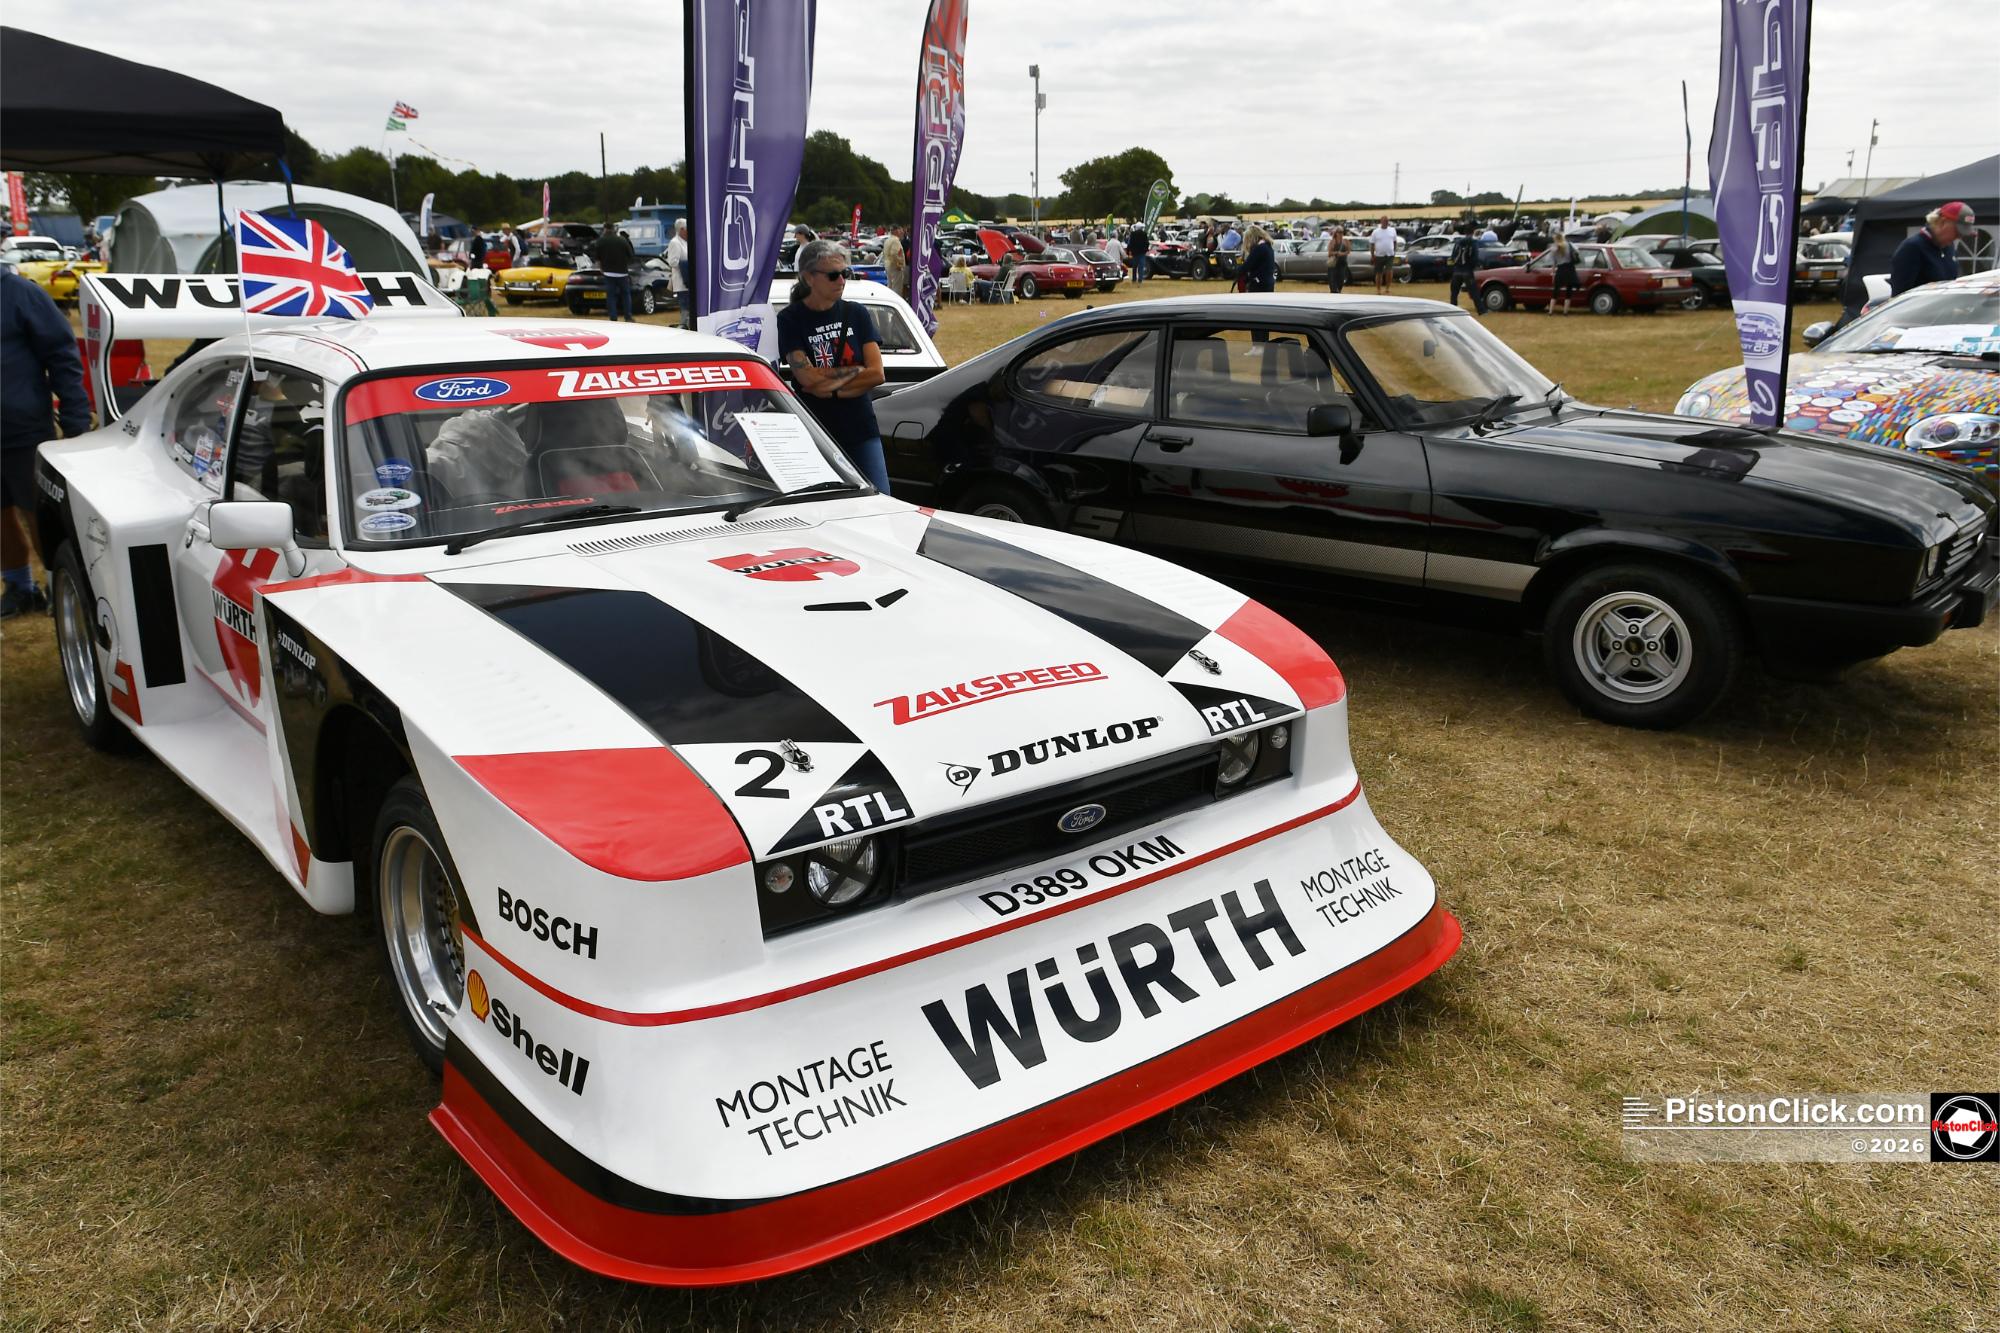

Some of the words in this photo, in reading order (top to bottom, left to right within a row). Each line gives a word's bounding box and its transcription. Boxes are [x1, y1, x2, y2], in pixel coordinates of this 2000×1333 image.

[97, 277, 427, 309] WÜH
[808, 334, 823, 343] FOR
[825, 322, 843, 331] STAN
[437, 380, 492, 399] Ford
[547, 366, 751, 397] ZAKSPEED
[212, 590, 258, 644] WÜRTH
[281, 632, 316, 670] DUNLOP
[873, 662, 1108, 726] ZAKSPEED
[1203, 699, 1267, 733] RTL
[988, 717, 1158, 777] DUNLOP
[734, 750, 790, 799] 2
[813, 791, 907, 837] RTL
[1070, 810, 1096, 828] Ford
[978, 869, 1088, 916] D389
[1088, 835, 1186, 878] OKM
[1301, 848, 1390, 903] MONTAGE
[498, 887, 598, 960] BOSCH
[1316, 877, 1403, 928] TECHNIK
[921, 878, 1306, 1089] WÜRTH
[491, 998, 590, 1096] Shell
[715, 1040, 892, 1128] MONTAGE
[747, 1078, 907, 1156] TECHNIK
